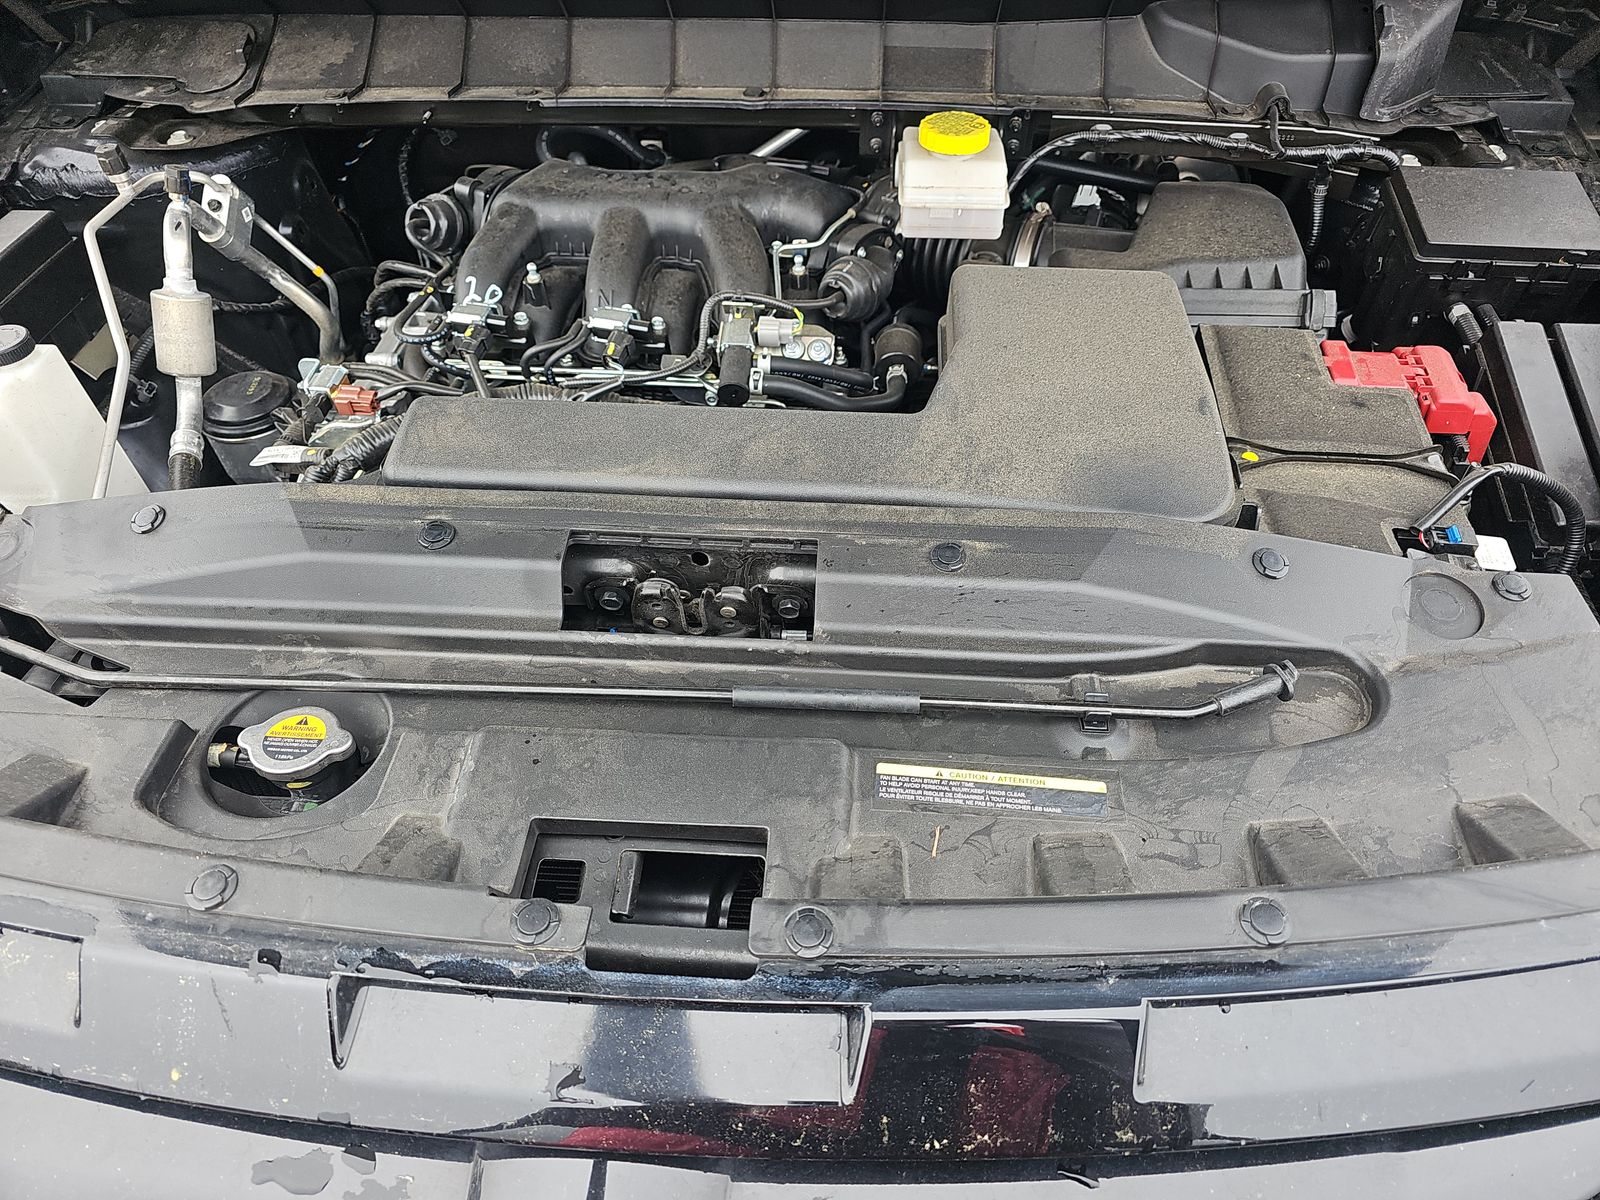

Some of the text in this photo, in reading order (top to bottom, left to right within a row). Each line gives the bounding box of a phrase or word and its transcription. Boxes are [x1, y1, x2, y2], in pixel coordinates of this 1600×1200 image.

[949, 772, 988, 781] CAUTION
[998, 776, 1046, 786] ATTENTION
[954, 792, 985, 800] DÉMARRER
